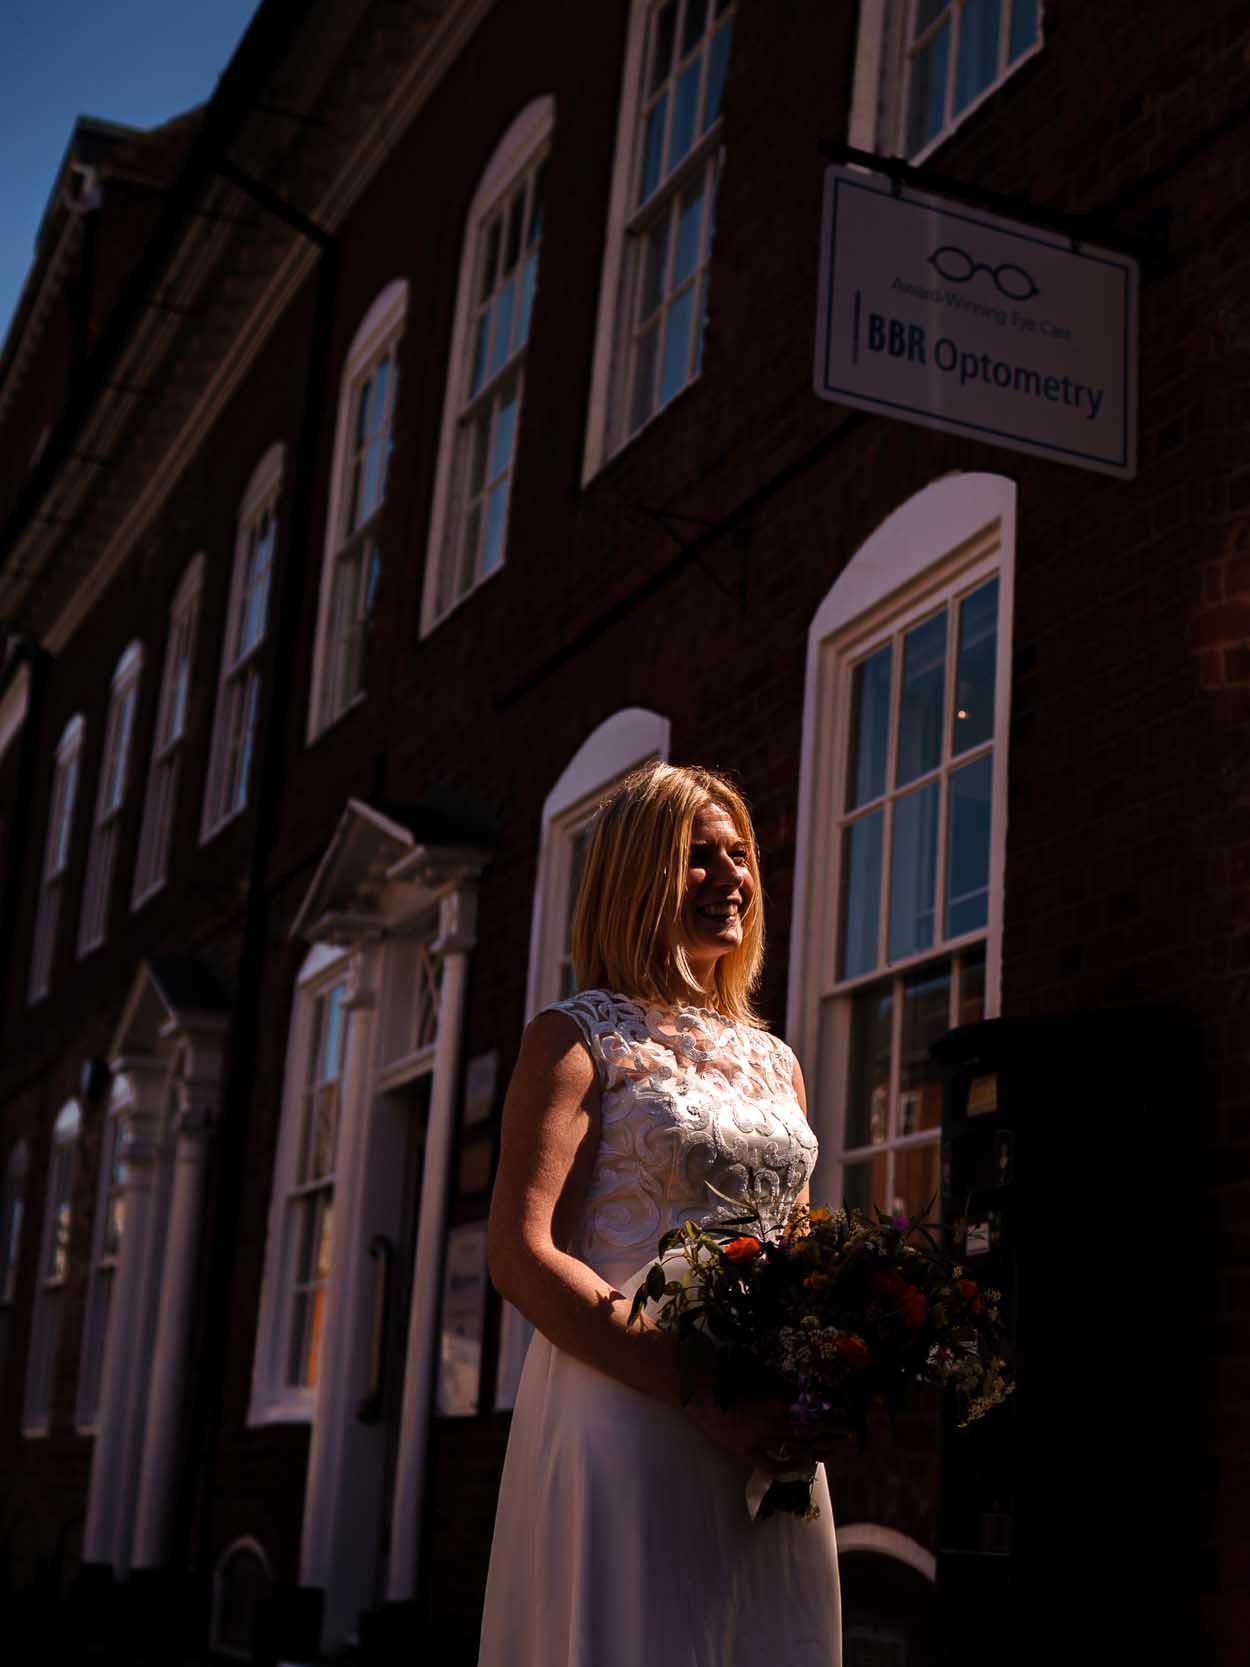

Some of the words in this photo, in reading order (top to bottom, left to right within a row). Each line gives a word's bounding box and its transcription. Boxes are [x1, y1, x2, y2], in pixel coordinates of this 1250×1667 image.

[1012, 311, 1035, 331] Eye
[1040, 319, 1072, 340] Care
[868, 313, 926, 364] BBR
[935, 338, 1103, 419] Optometry
